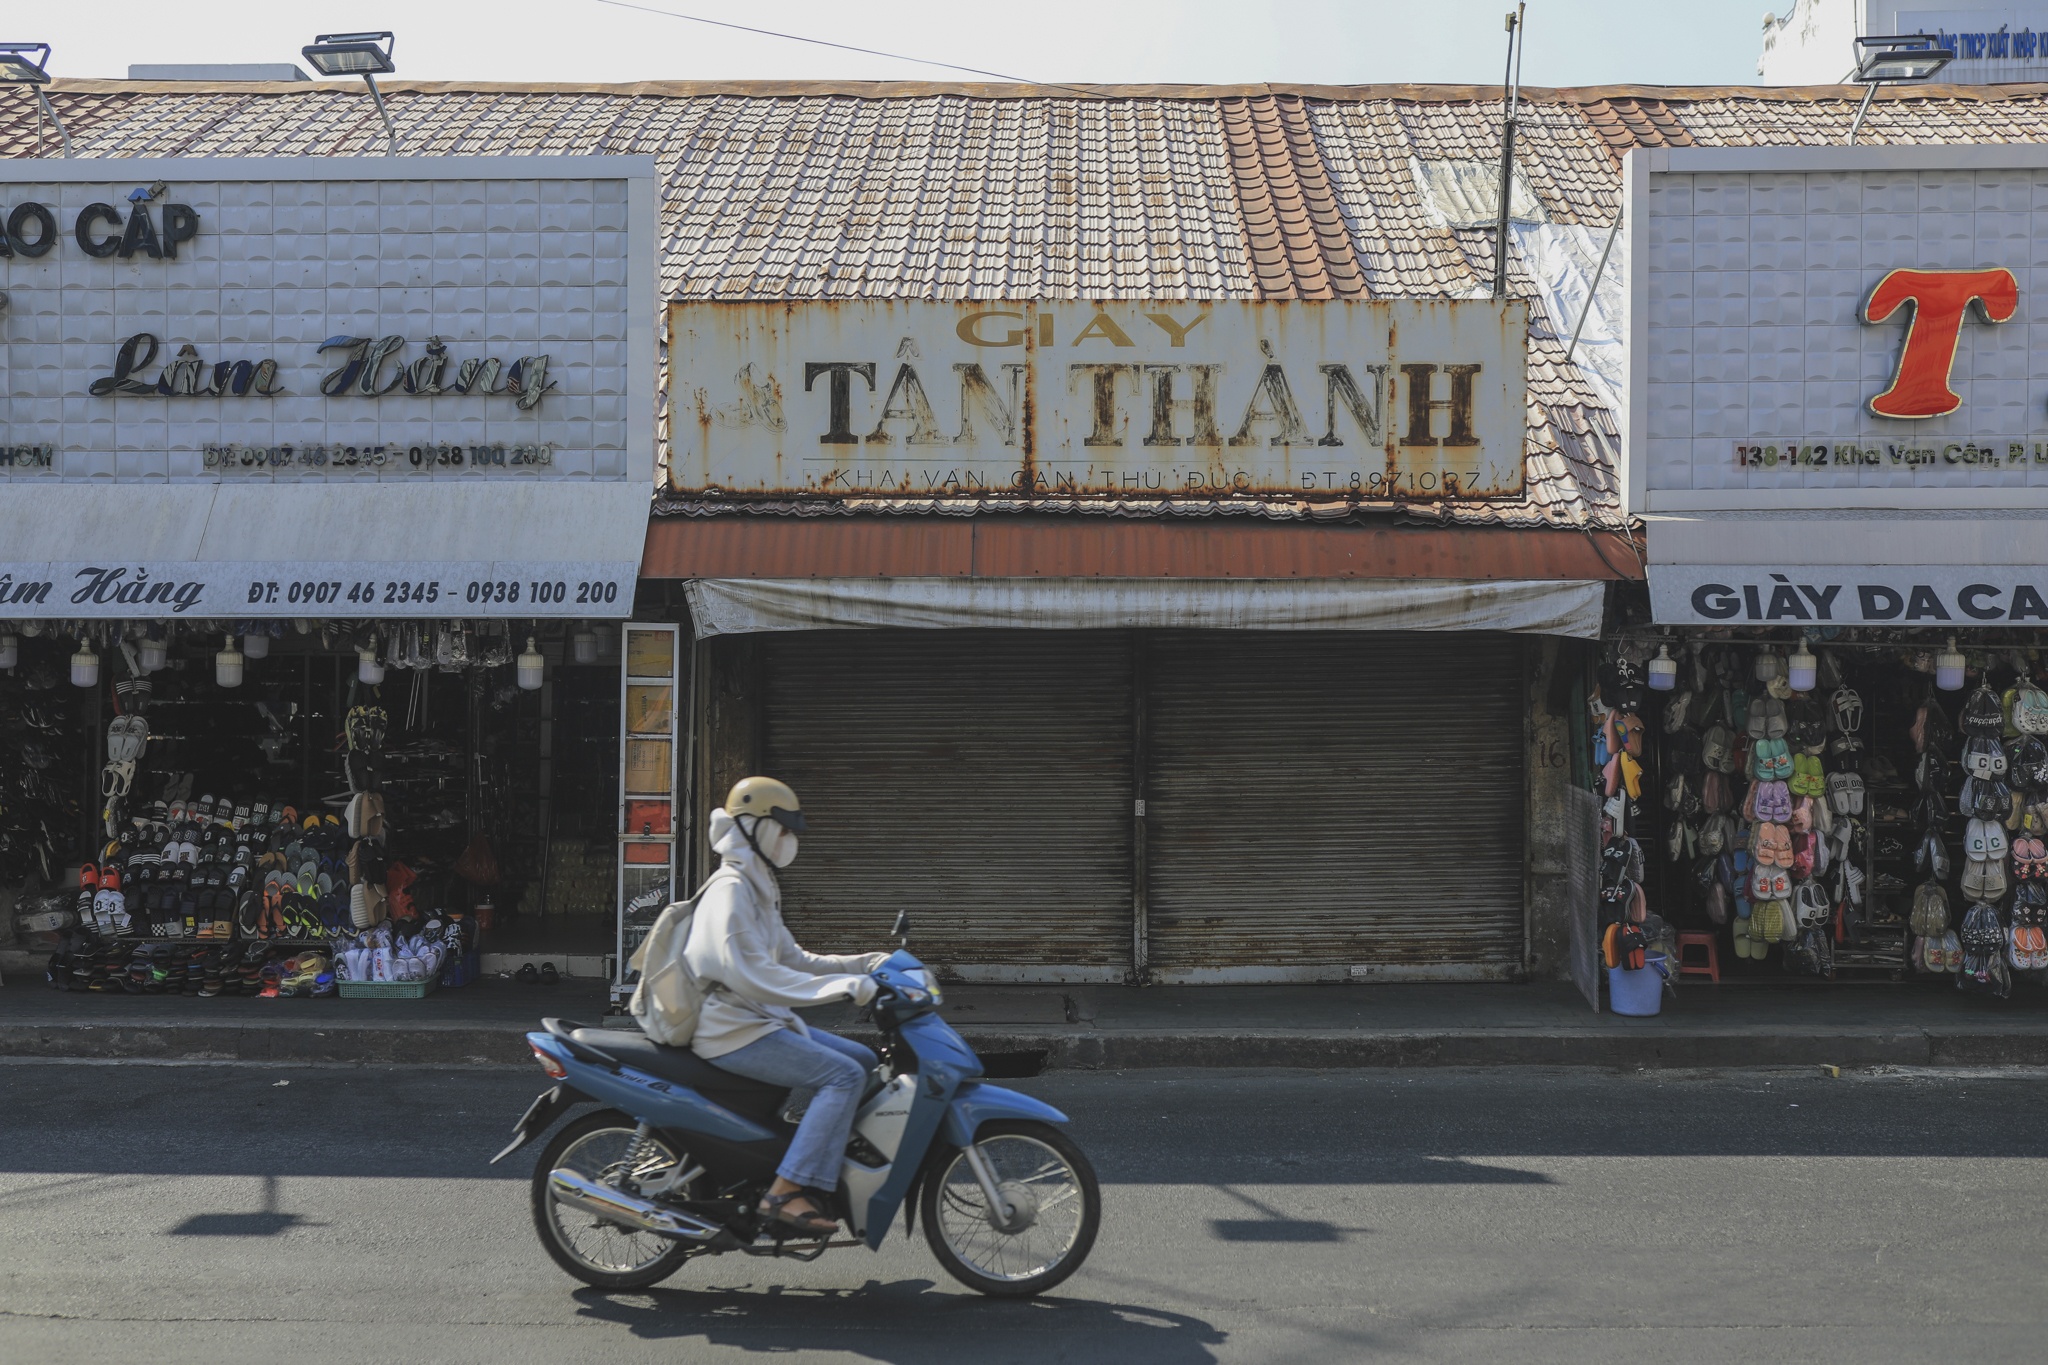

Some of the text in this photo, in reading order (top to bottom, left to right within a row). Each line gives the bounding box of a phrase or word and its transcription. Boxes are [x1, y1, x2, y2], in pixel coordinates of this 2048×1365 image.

[1959, 33, 1987, 59] TMCP
[1987, 23, 2010, 59] XUẤT
[2012, 27, 2037, 63] NHẬP
[75, 180, 200, 259] CẤP
[1861, 267, 2019, 419] T
[88, 332, 285, 397] Lâm
[804, 337, 1483, 446] TÂN THÀNH
[240, 447, 293, 467] 0907
[298, 447, 327, 467] 46
[332, 447, 386, 467] 2345
[409, 446, 463, 466] 0938
[469, 446, 505, 466] 100
[510, 446, 551, 465] 200
[1737, 446, 1828, 466] 138-142
[1834, 446, 1880, 465] Kha
[2008, 443, 2027, 464] P.
[834, 469, 896, 488] KHA
[1301, 472, 1337, 490] ĐT
[70, 567, 206, 612] Hằng
[247, 582, 280, 604] ĐT:
[287, 581, 342, 604] 0907
[346, 582, 375, 604] 46
[383, 581, 440, 604] 2345
[466, 581, 520, 604] 0938
[530, 581, 567, 604] 100
[576, 581, 618, 604] 200
[1690, 573, 1842, 621] GIÀY
[1857, 583, 1952, 621] DA
[1540, 739, 1567, 768] 16
[1974, 837, 2000, 850] C C
[874, 1109, 909, 1117] HONDA
